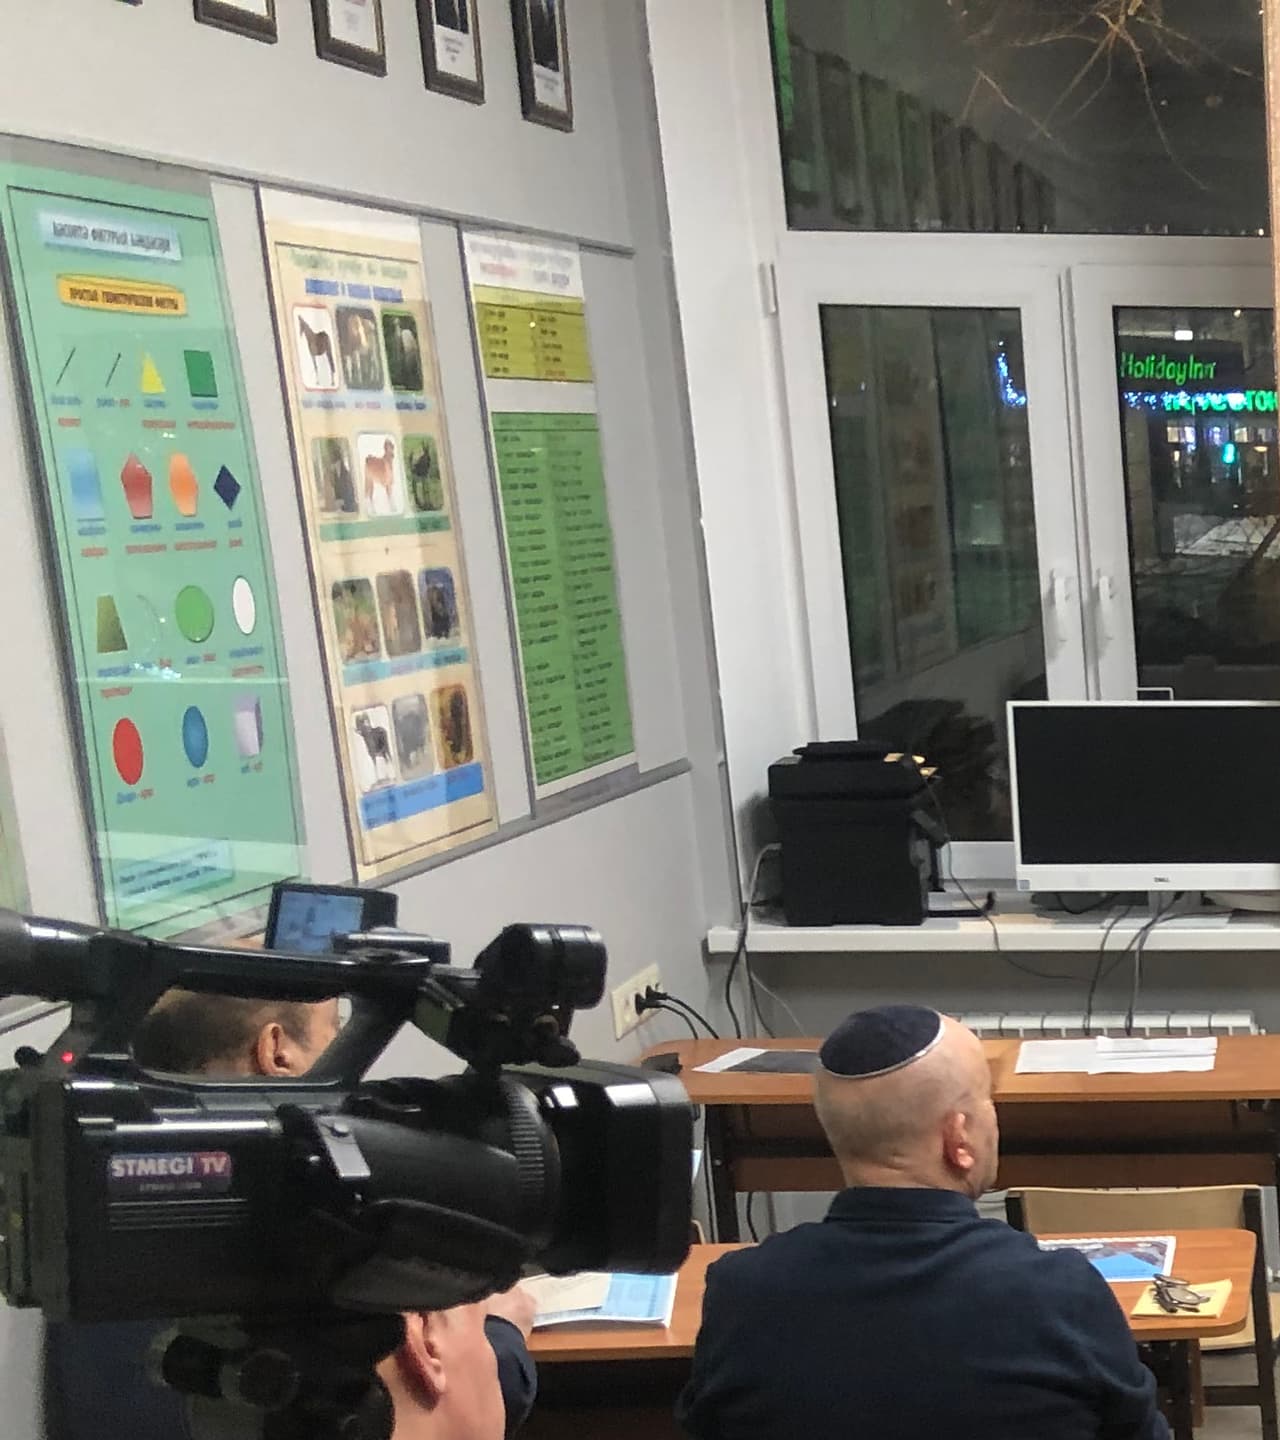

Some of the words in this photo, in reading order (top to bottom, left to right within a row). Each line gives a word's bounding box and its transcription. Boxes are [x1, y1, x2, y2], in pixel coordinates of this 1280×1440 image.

[1121, 351, 1187, 385] Holiday
[1188, 353, 1217, 380] Inn
[111, 1156, 194, 1178] STMEGI
[200, 1156, 228, 1174] TV
